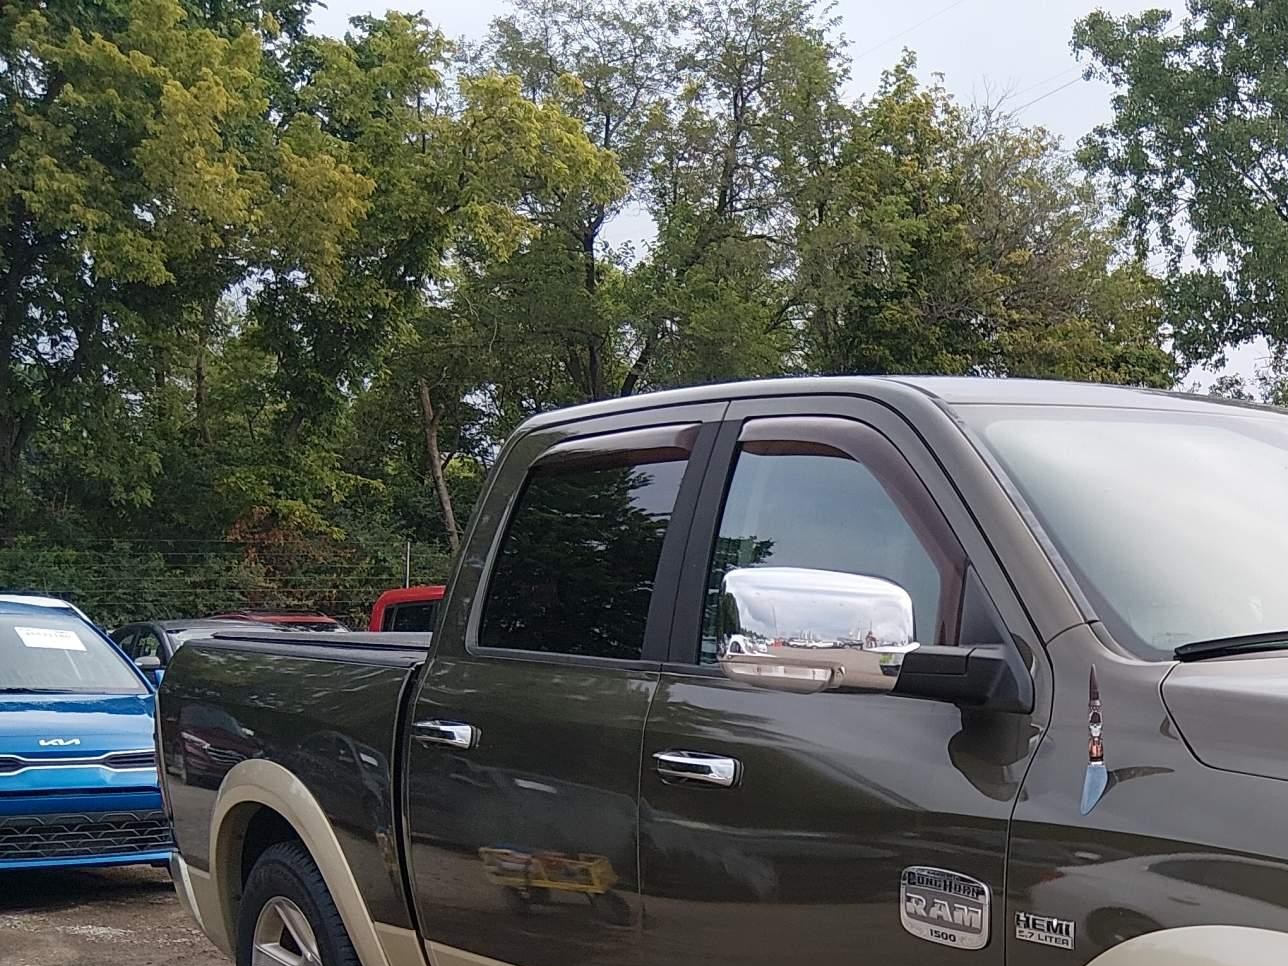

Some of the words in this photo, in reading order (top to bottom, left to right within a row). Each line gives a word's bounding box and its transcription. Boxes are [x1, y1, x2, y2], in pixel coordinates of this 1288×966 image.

[905, 892, 983, 930] RAM
[1015, 911, 1071, 938] HEMI
[929, 928, 957, 943] 1500
[1037, 933, 1070, 947] LITER
